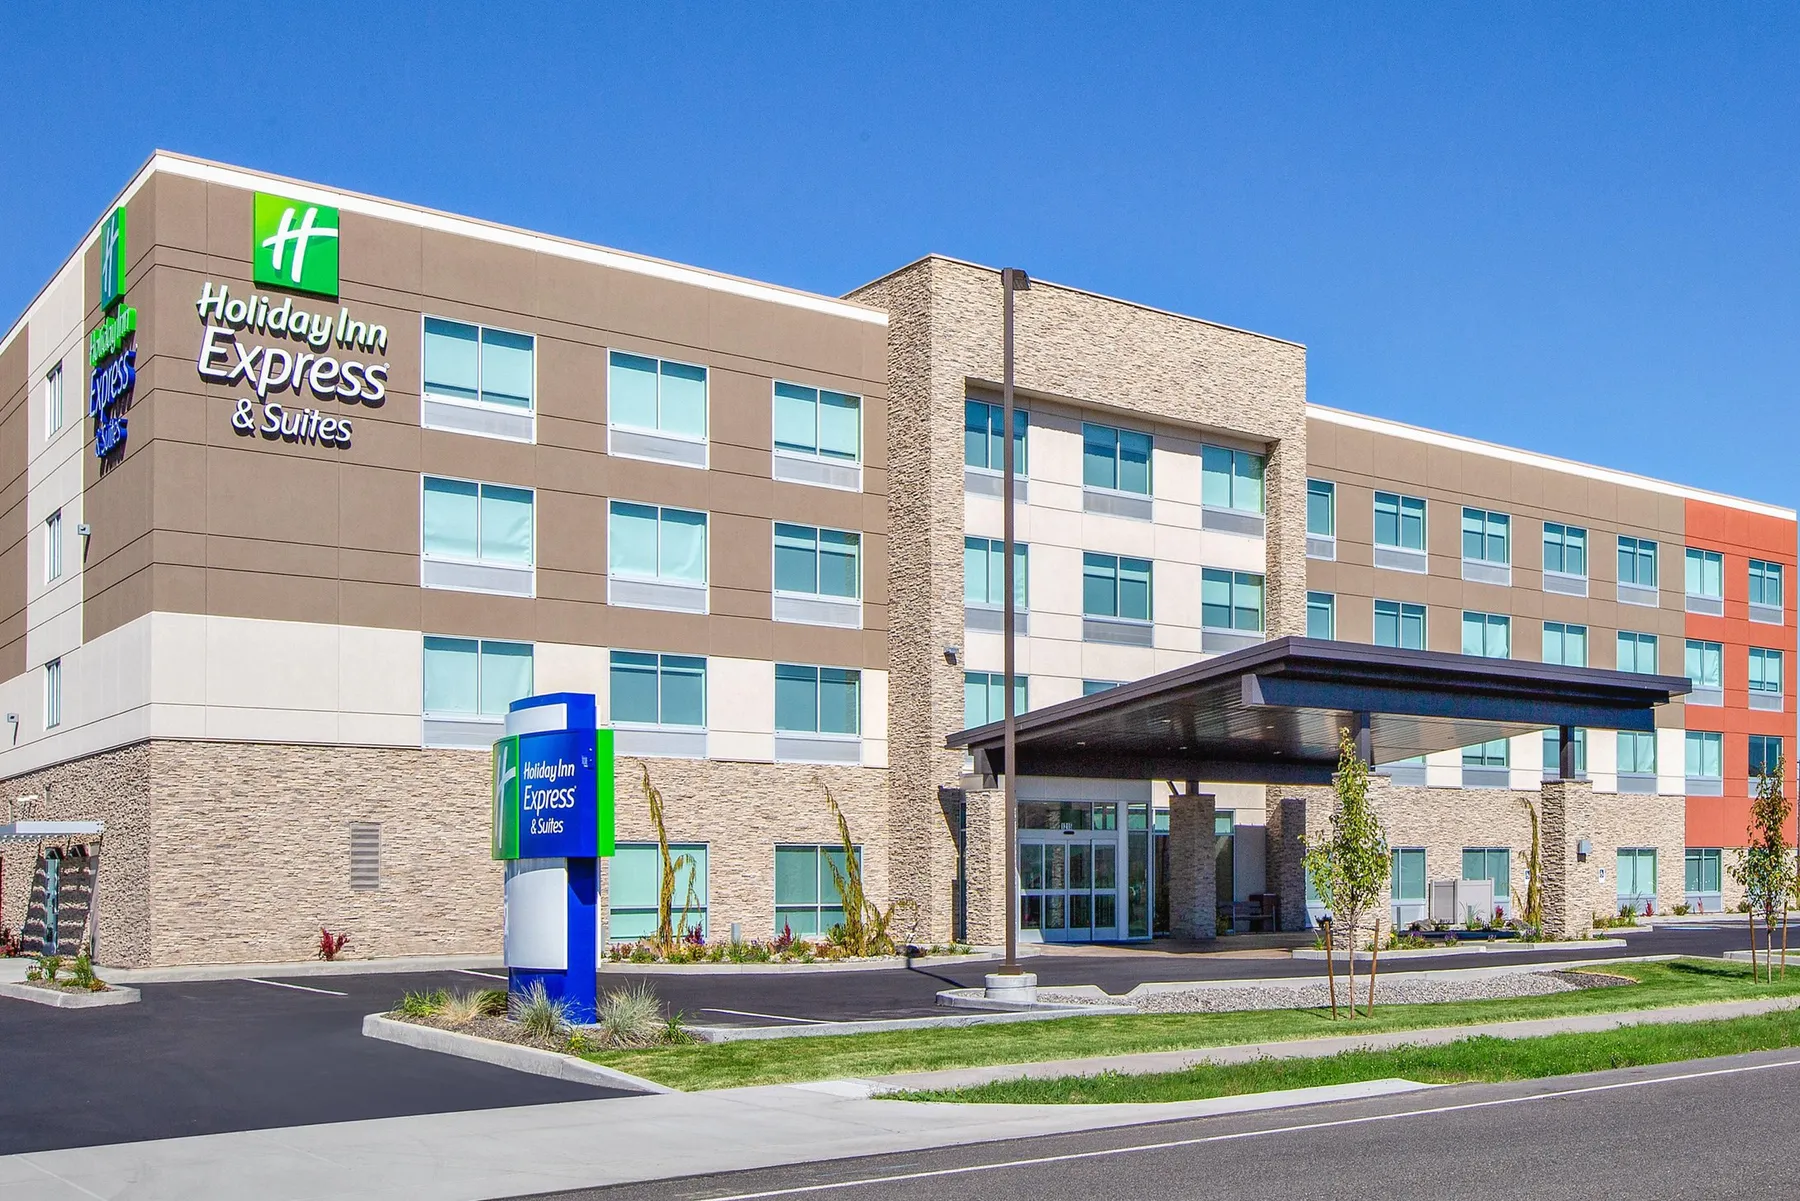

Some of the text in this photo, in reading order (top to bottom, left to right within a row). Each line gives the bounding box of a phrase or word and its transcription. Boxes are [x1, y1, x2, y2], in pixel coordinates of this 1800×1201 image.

[196, 282, 387, 348] Holiday Inn
[198, 325, 388, 399] Express
[89, 350, 129, 423] Express
[101, 418, 121, 453] Suites
[231, 398, 352, 442] & Suites
[523, 758, 575, 783] Holiday Inn
[523, 785, 575, 817] Express
[530, 817, 564, 835] & Suites
